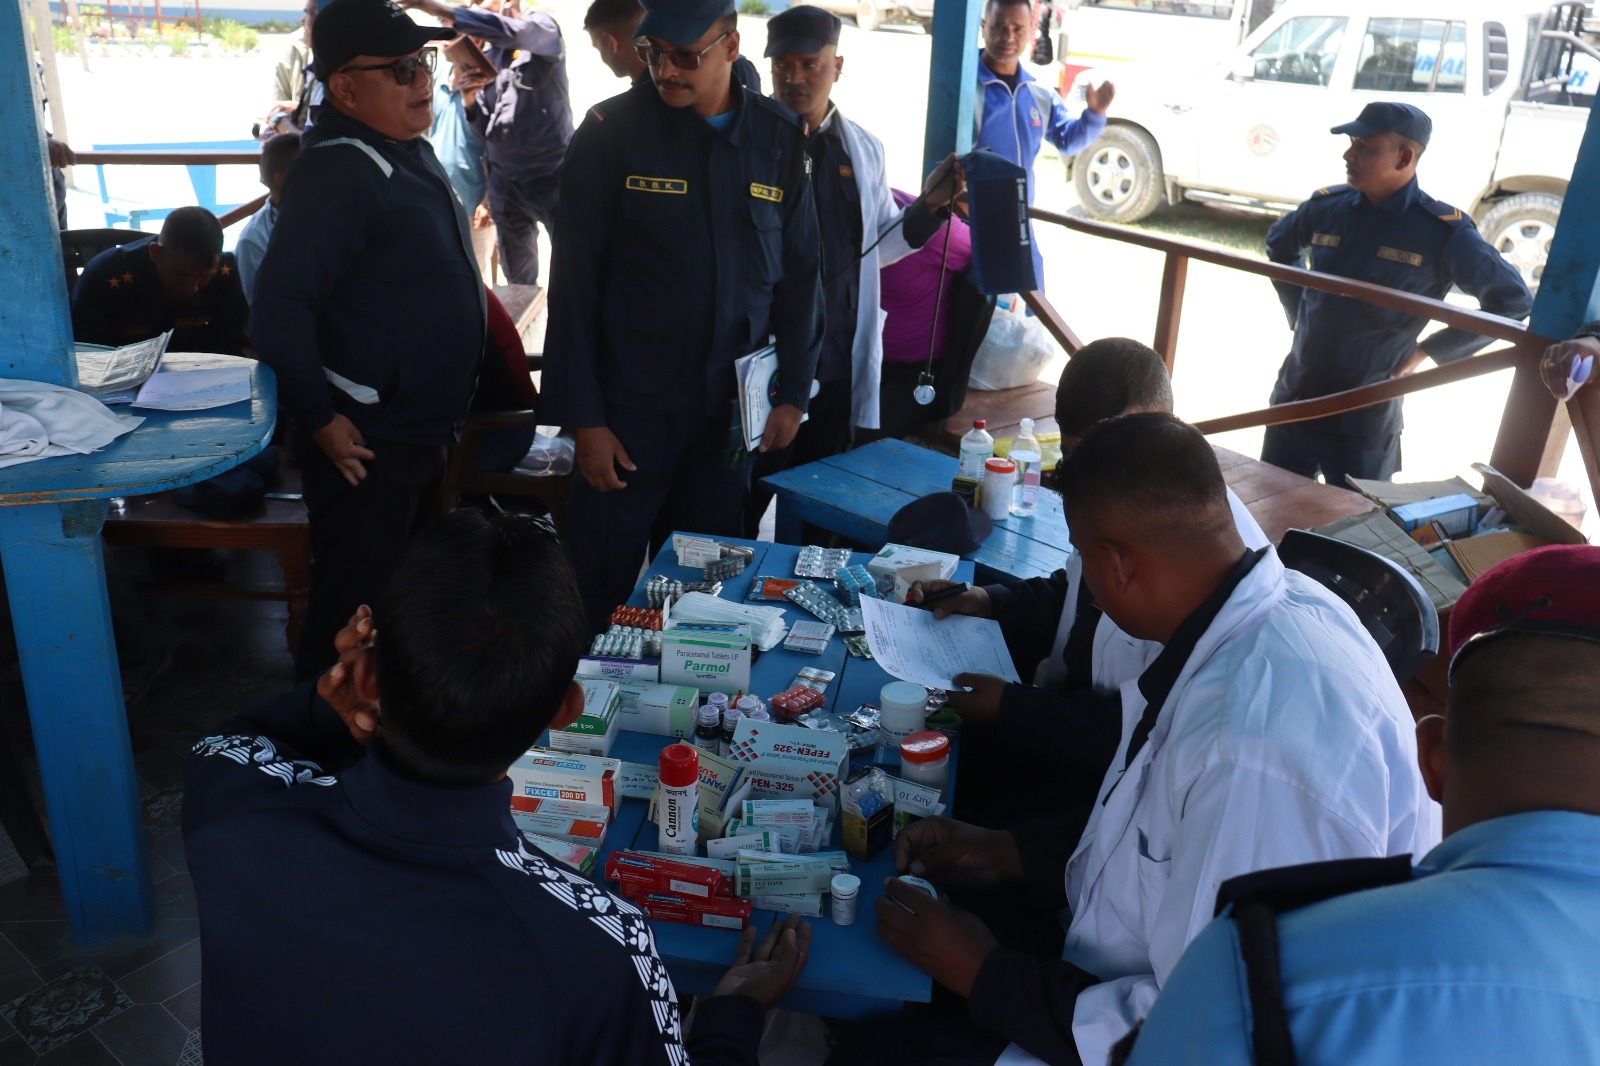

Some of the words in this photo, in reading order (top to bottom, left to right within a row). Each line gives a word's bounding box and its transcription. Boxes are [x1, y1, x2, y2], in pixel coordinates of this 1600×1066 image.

[665, 182, 674, 190] K.
[676, 649, 710, 659] Paracetamol
[711, 651, 730, 660] Tablets
[683, 659, 731, 673] Parmol
[773, 743, 830, 759] FEPEN-325
[698, 766, 718, 779] PLUS
[743, 776, 795, 792] FPEN-325
[525, 787, 558, 797] FIXCEF
[560, 791, 574, 799] 200
[575, 792, 585, 800] DT
[899, 791, 910, 800] 10
[913, 794, 932, 807] Airy
[665, 798, 677, 838] Cannon
